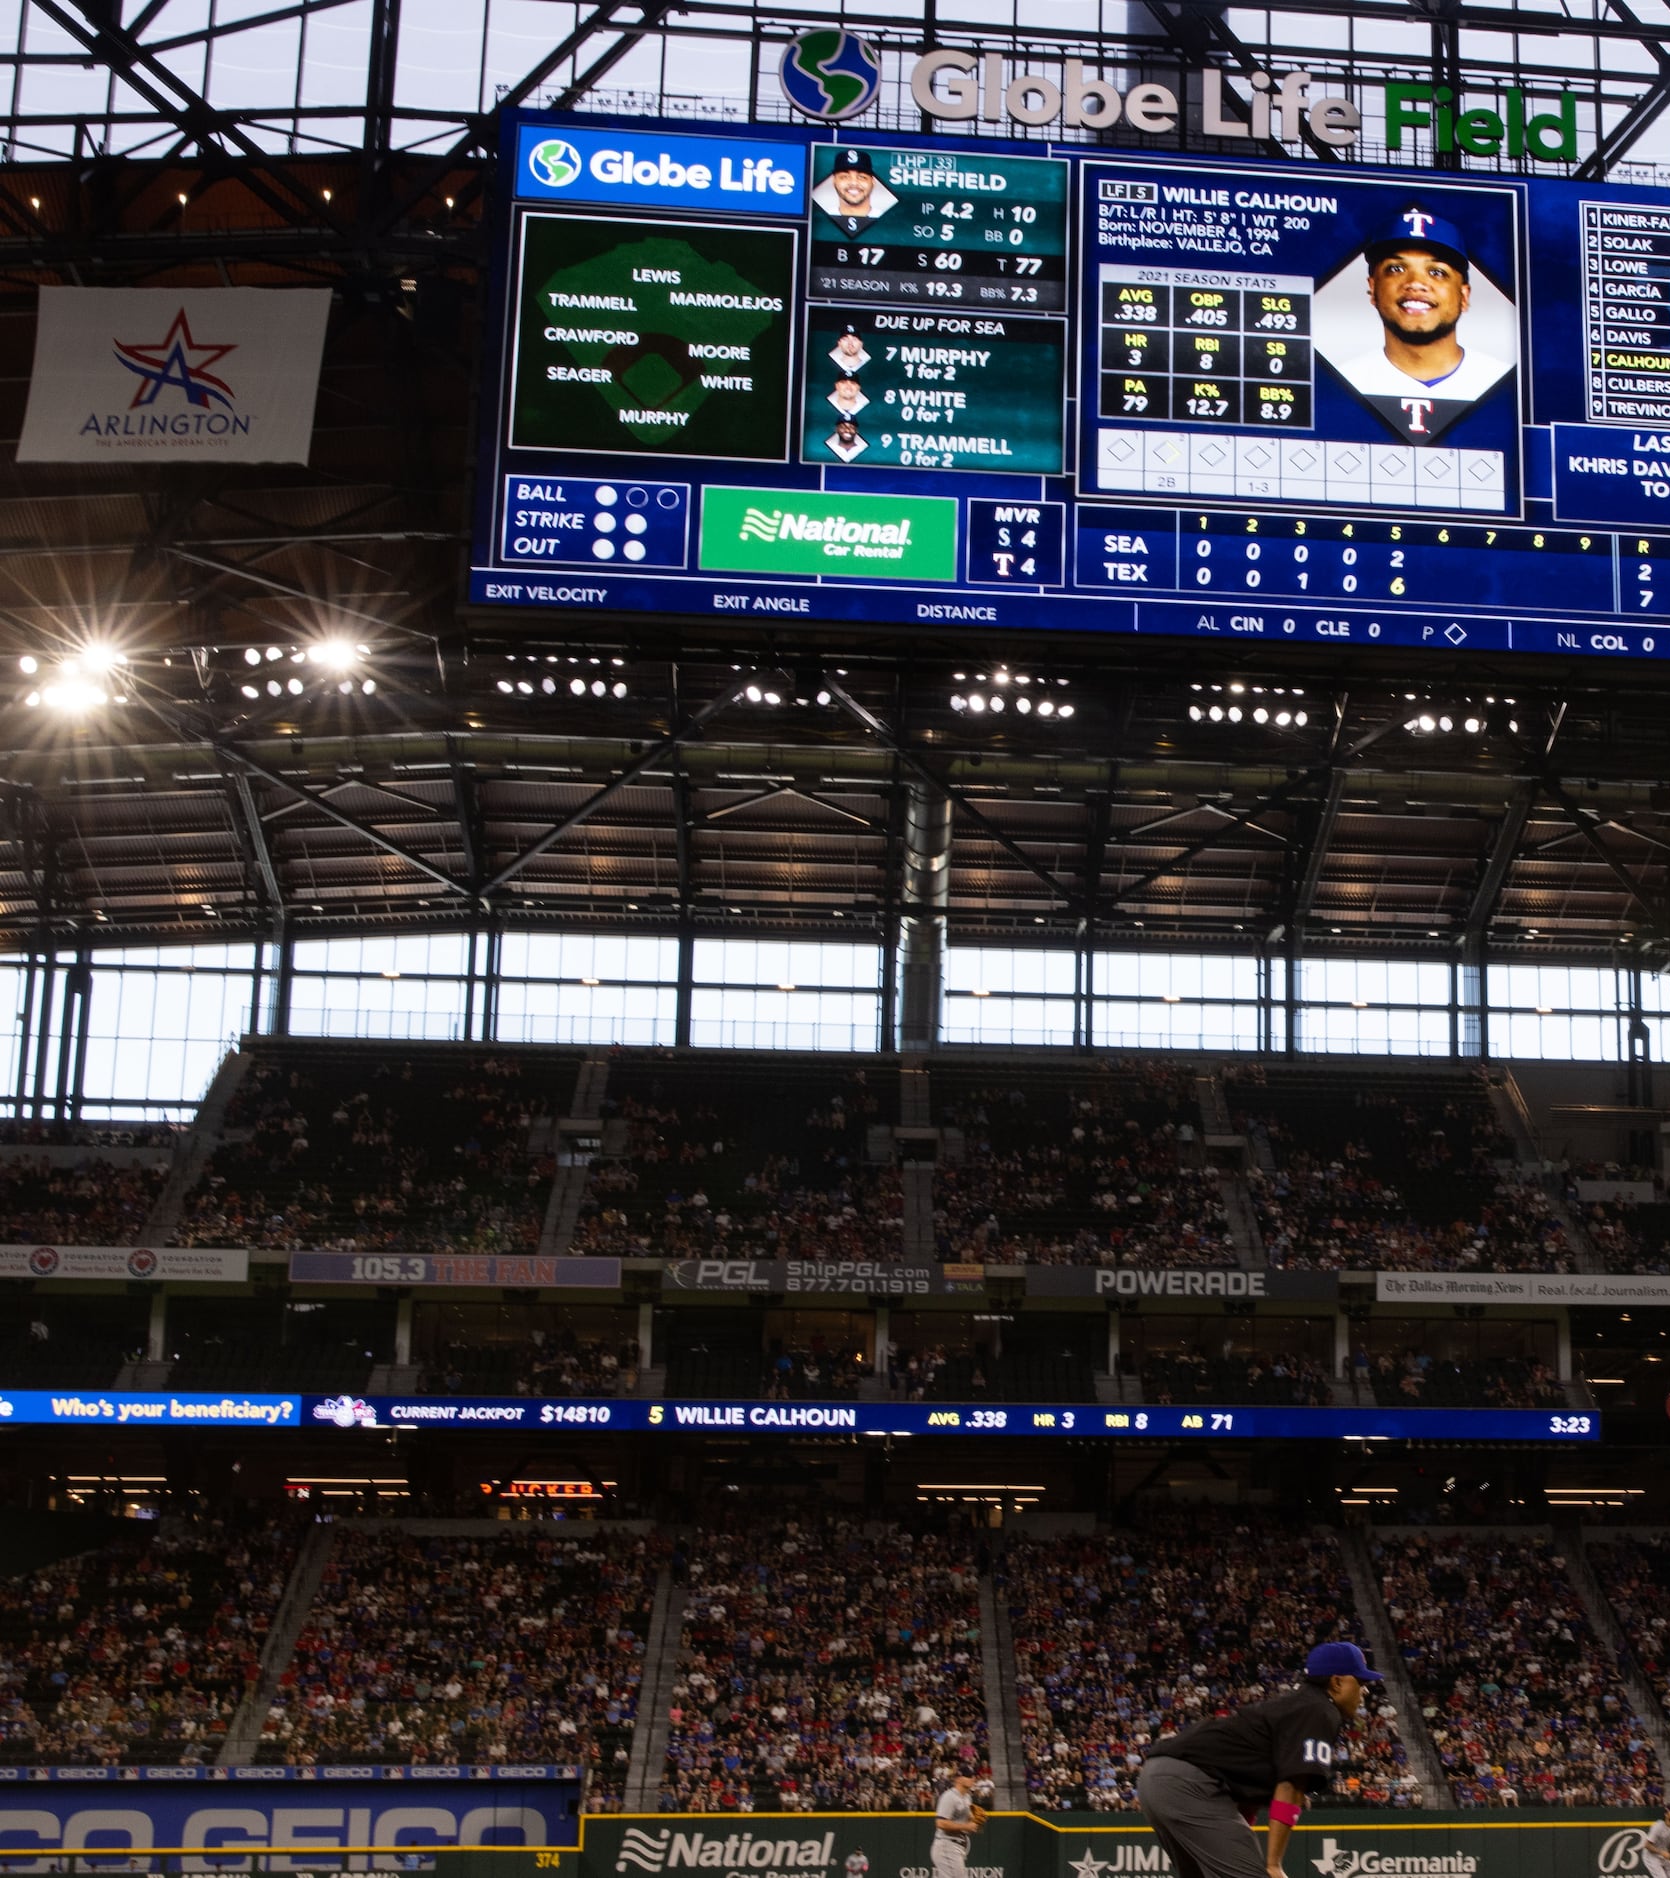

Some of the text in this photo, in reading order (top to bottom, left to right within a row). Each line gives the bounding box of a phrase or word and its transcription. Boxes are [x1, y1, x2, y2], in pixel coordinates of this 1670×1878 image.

[910, 48, 1579, 163] Globe Life Field
[590, 149, 796, 197] Globe Life
[888, 167, 1007, 192] SHEFFIELD
[1106, 184, 1146, 199] LF 5
[1162, 186, 1338, 214] WILLIE CALHOUN
[1099, 220, 1280, 242] Born: NOVEMBER 4, 1994
[1099, 232, 1273, 256] Birthplace: VALLEJO, CA
[1603, 237, 1653, 252] SOLAK
[632, 268, 682, 284] LEWIS
[1604, 260, 1648, 275] LOWE
[1137, 270, 1277, 289] 2021 SEASON STATS
[840, 279, 890, 293] SEASON
[926, 281, 963, 298] 19.3
[980, 287, 1006, 300] BB%
[1010, 287, 1038, 302] 7.3
[1119, 289, 1291, 312] AVG OBP SLG
[548, 292, 638, 312] TRAMMELL
[669, 291, 783, 312] MARMOLEJOS
[1114, 304, 1297, 331] .338 .405 .493
[1606, 306, 1656, 322] GALLO
[875, 314, 1005, 336] DUE UP FOR SEA
[543, 326, 639, 345] CRAWFORD
[1607, 329, 1651, 345] DAVIS
[688, 344, 751, 360] MOORE
[885, 346, 991, 367] 7 MURPHY
[547, 366, 612, 384] SEAGER
[701, 375, 753, 391] WHITE
[884, 389, 967, 409] 8 WHITE
[80, 413, 250, 435] ARLINGTON
[619, 409, 690, 426] MURPHY
[880, 433, 1013, 456] 9 TRAMMELL
[1569, 455, 1628, 476] KHRIS
[516, 484, 566, 502] BALL
[1641, 480, 1670, 498] TO
[515, 510, 585, 530] STRIKE
[995, 506, 1041, 525] MVR
[513, 537, 560, 555] OUT
[823, 543, 904, 559] Car Rental
[1104, 534, 1149, 555] SEA
[1104, 562, 1148, 583] TEX
[486, 583, 607, 603] EXIT VELOCITY
[713, 594, 810, 613] EXIT ANGLE
[917, 603, 997, 622] DISTANCE
[352, 1257, 557, 1284] 105.3 THE FAN
[696, 1261, 770, 1285] PGL
[786, 1261, 930, 1280] ShipPGL.com
[786, 1278, 930, 1293] 877.701.1919
[1095, 1270, 1266, 1296] POWERADE
[1385, 1280, 1523, 1295] The Dallas Morning News
[1538, 1285, 1566, 1296] Real.
[1602, 1285, 1670, 1297] Journalism.
[51, 1398, 114, 1417] Who's
[117, 1402, 166, 1422] your
[170, 1399, 293, 1423] beneficiary?
[390, 1406, 456, 1420] CURRENT
[458, 1406, 525, 1421] JACKPOT
[540, 1404, 610, 1423] $14810
[648, 1406, 855, 1427] 5 WILLIE CALHOUN
[927, 1411, 1233, 1430] AVG .338 HR 3 RBI 8 AB 71
[1549, 1416, 1590, 1434] 3:23
[1303, 1739, 1332, 1765] 10
[57, 1767, 546, 1779] GEICO GEICO GEICO GEICO GEICO GEICO
[181, 1807, 547, 1872] GEICO
[535, 1853, 560, 1869] 374
[1360, 1850, 1470, 1874] Germania
